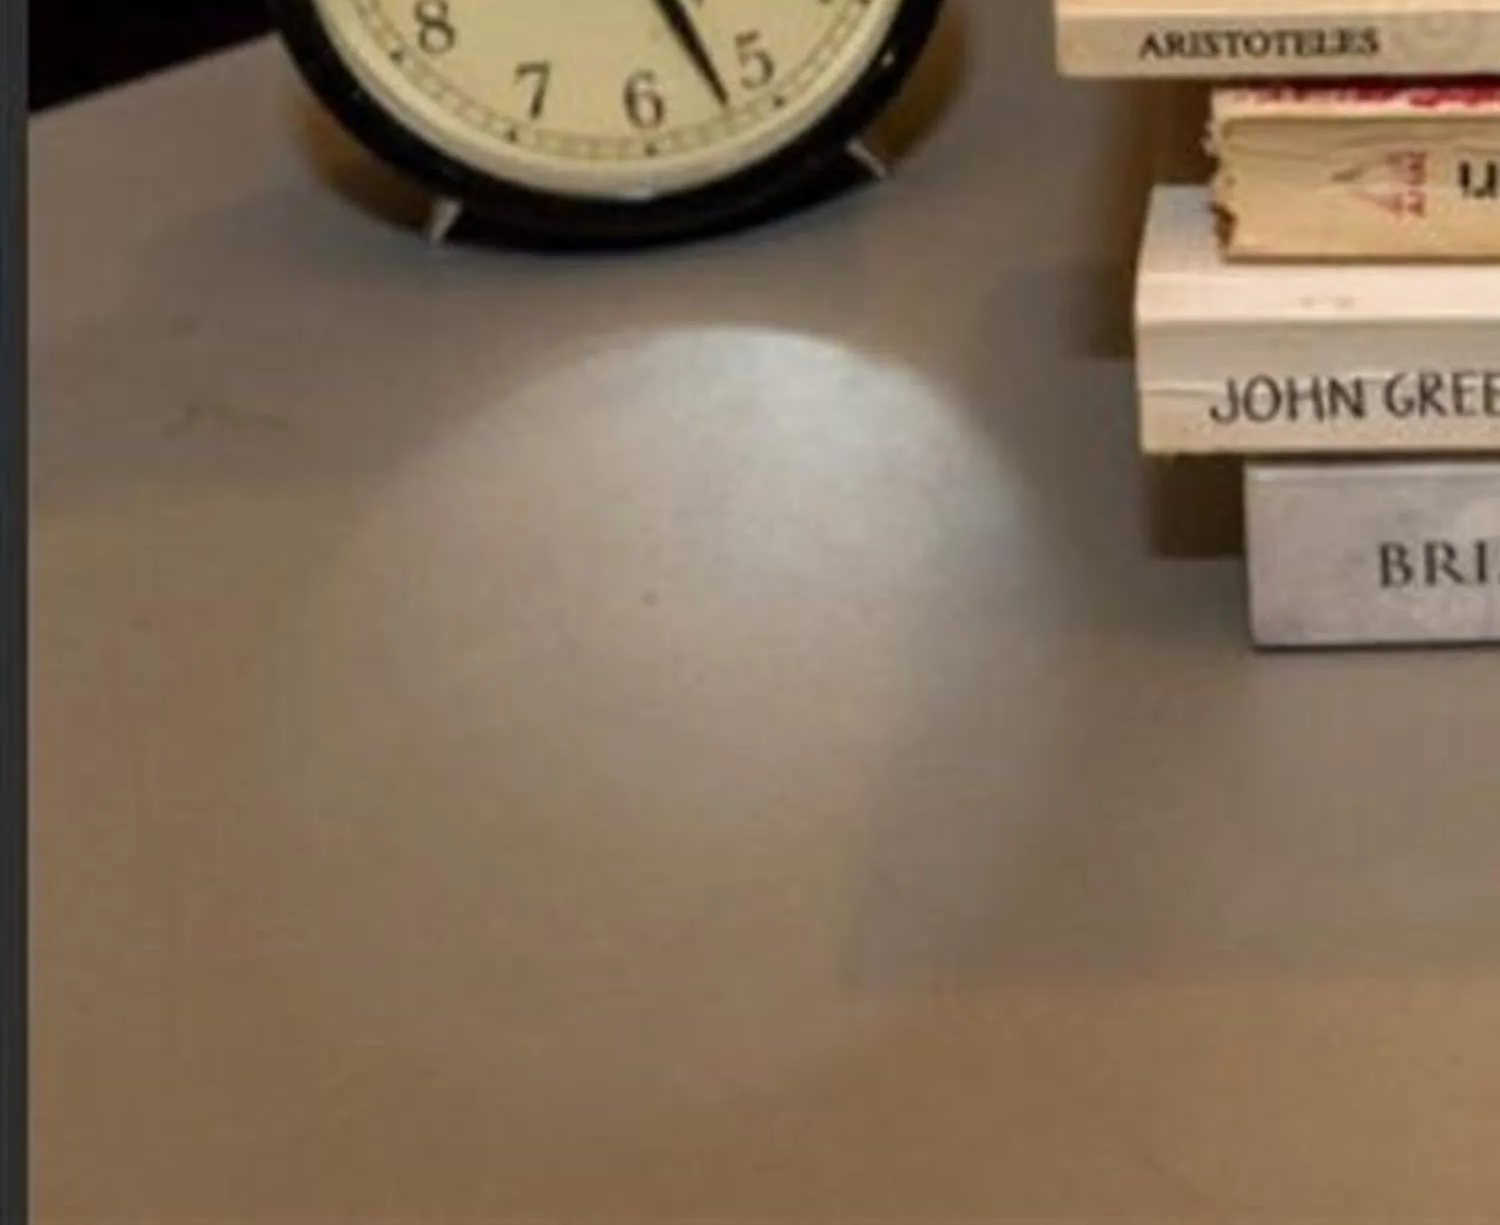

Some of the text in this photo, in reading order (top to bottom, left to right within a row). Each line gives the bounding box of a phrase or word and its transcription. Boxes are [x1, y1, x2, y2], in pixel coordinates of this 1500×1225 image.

[733, 30, 776, 91] 5
[1138, 27, 1381, 60] ARISTOTELES
[514, 60, 551, 120] 7
[622, 75, 666, 129] 6
[1208, 374, 1367, 425] JOHN
